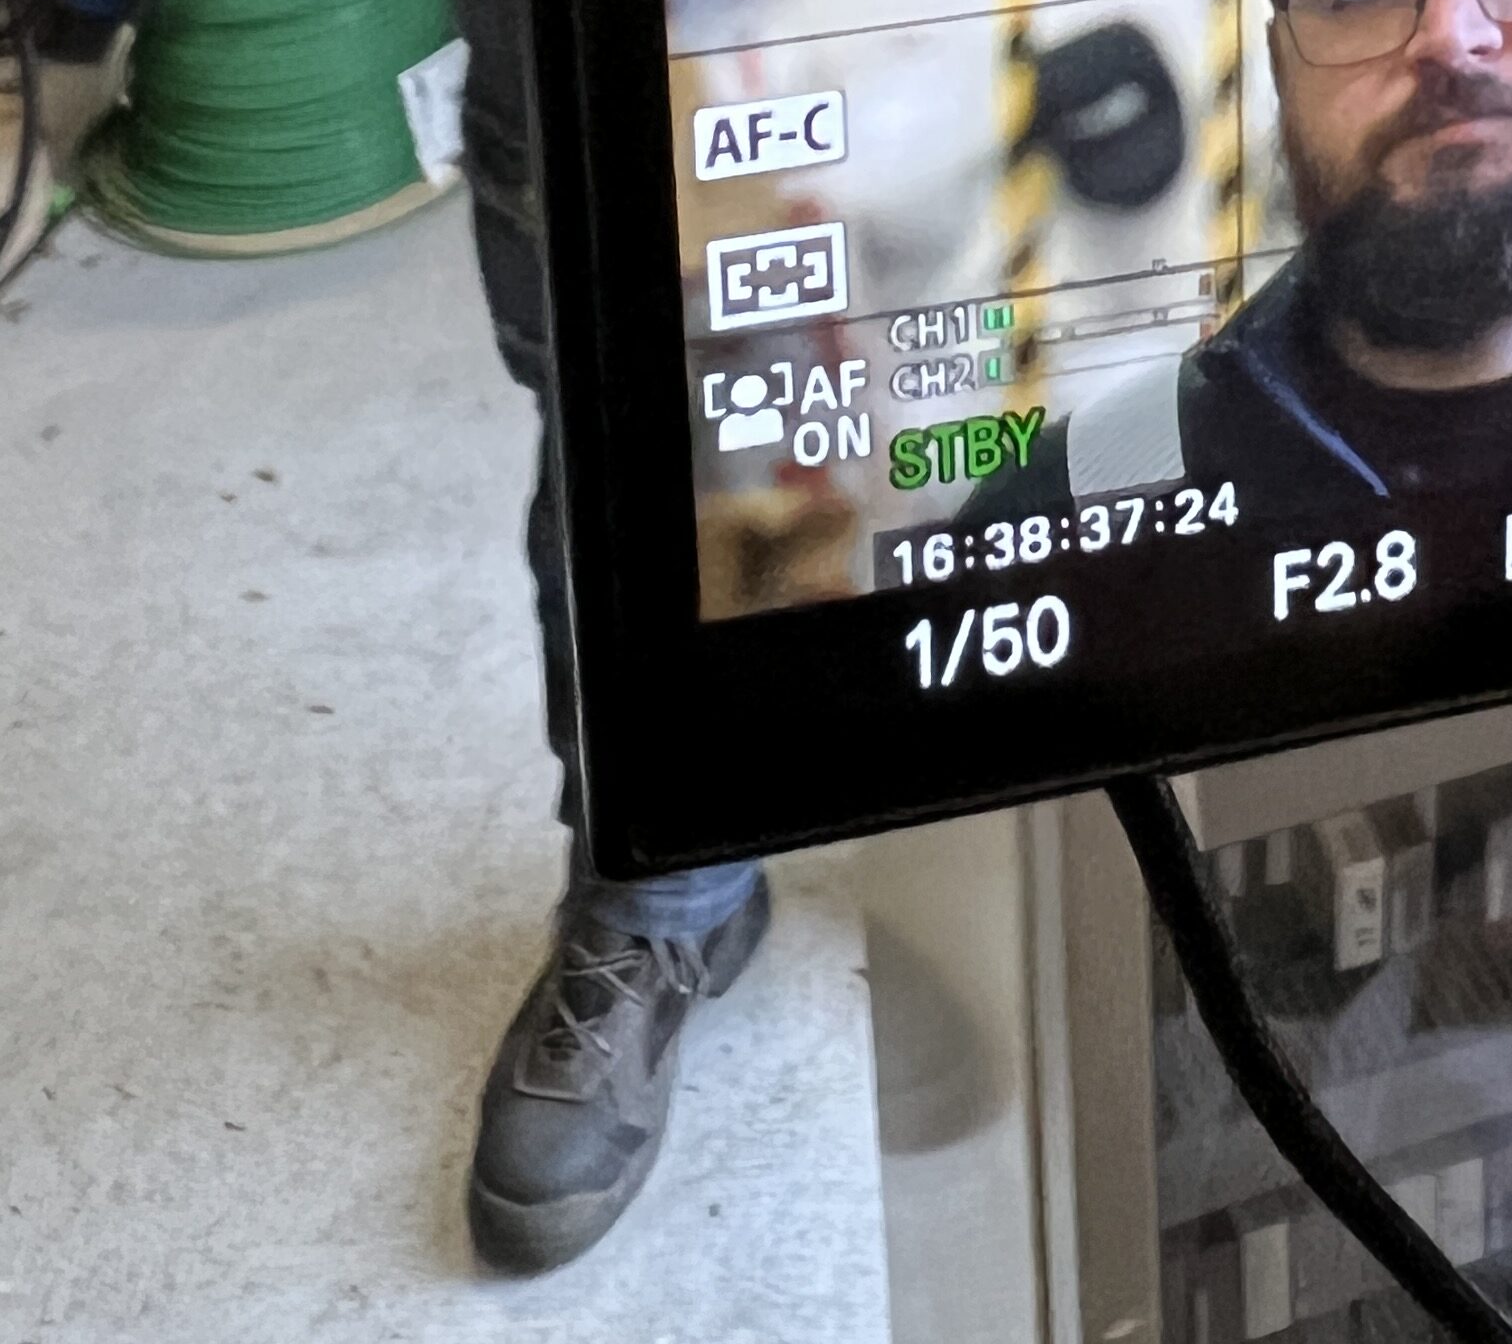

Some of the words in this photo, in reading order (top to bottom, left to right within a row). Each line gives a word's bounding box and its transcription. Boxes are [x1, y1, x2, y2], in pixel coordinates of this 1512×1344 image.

[704, 103, 831, 168] AF-C
[889, 305, 969, 352] CH1
[800, 359, 867, 412] AF
[889, 355, 976, 400] CH2
[793, 413, 871, 467] ON
[889, 406, 1046, 490] STBY
[893, 480, 1239, 586] 16:38:37:24
[1273, 529, 1417, 622] F2.8
[904, 594, 1070, 689] 1/50
